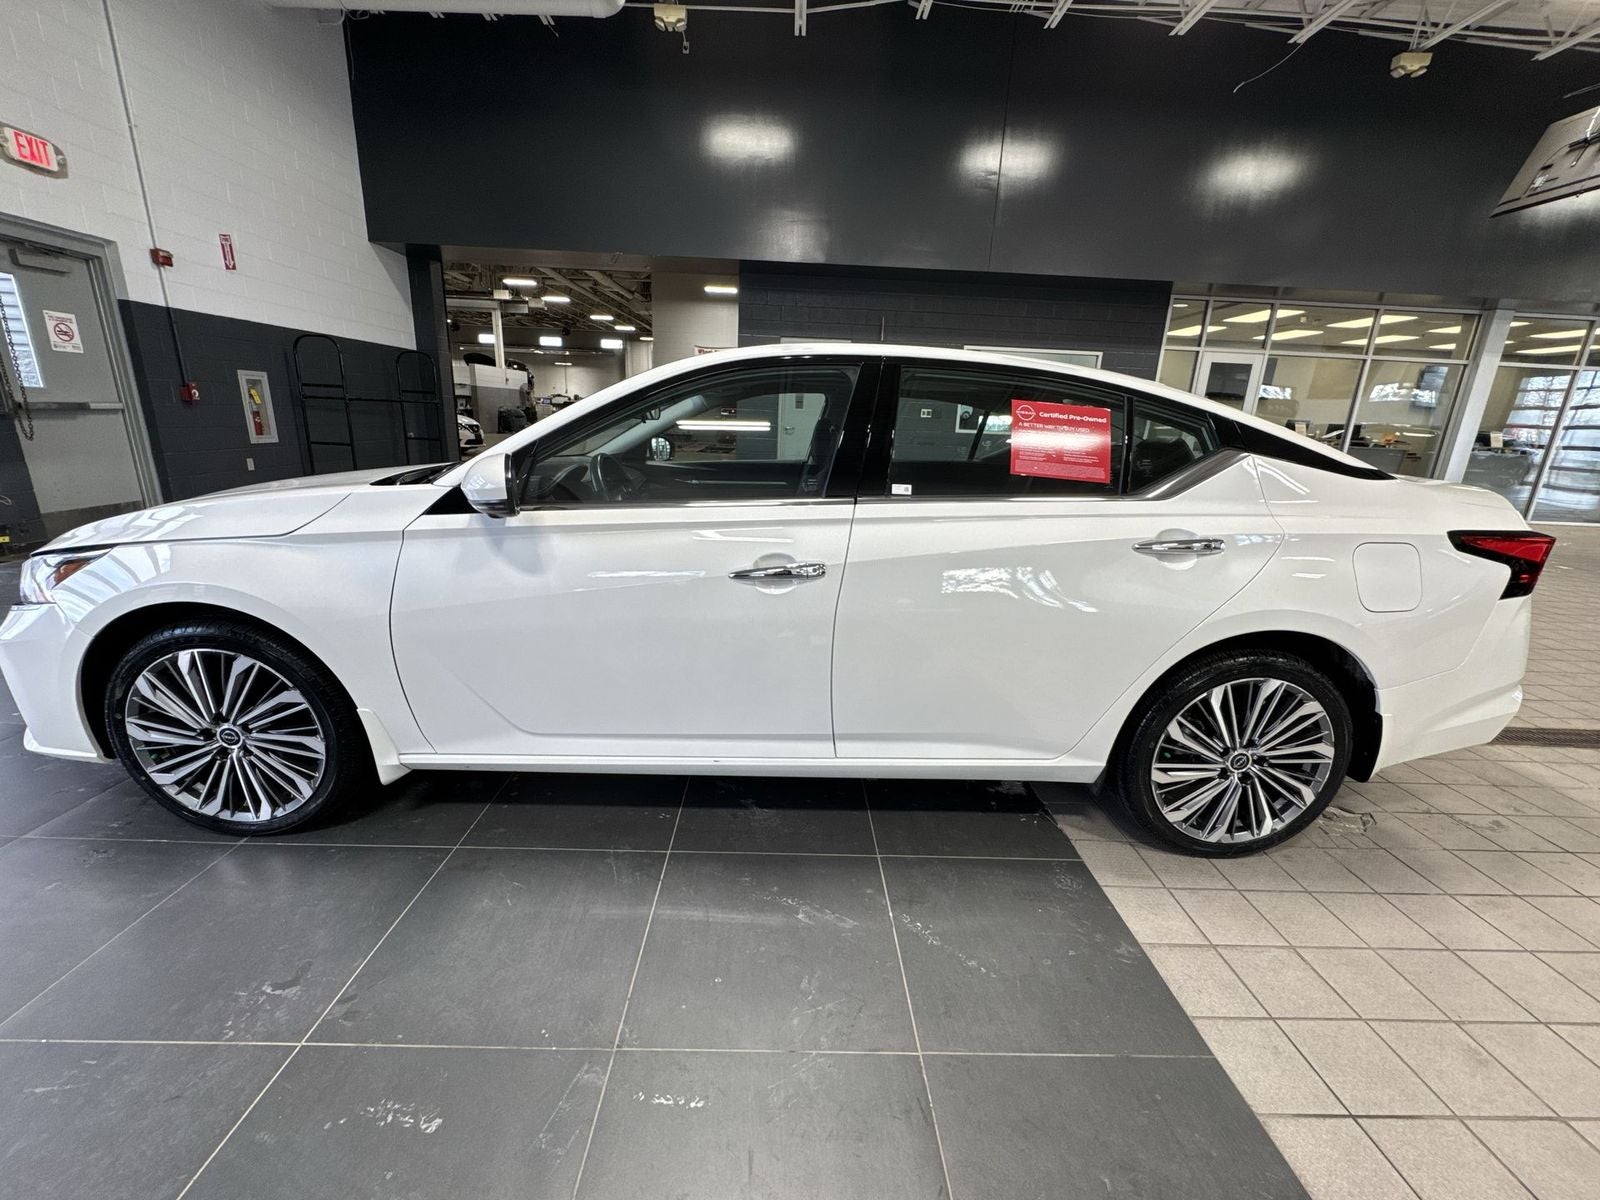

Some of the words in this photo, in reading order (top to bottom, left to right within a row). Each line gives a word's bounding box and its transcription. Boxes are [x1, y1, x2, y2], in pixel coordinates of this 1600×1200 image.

[13, 131, 50, 167] EXIT
[1039, 412, 1068, 420] Certified
[1069, 414, 1107, 423] Pre-Owned
